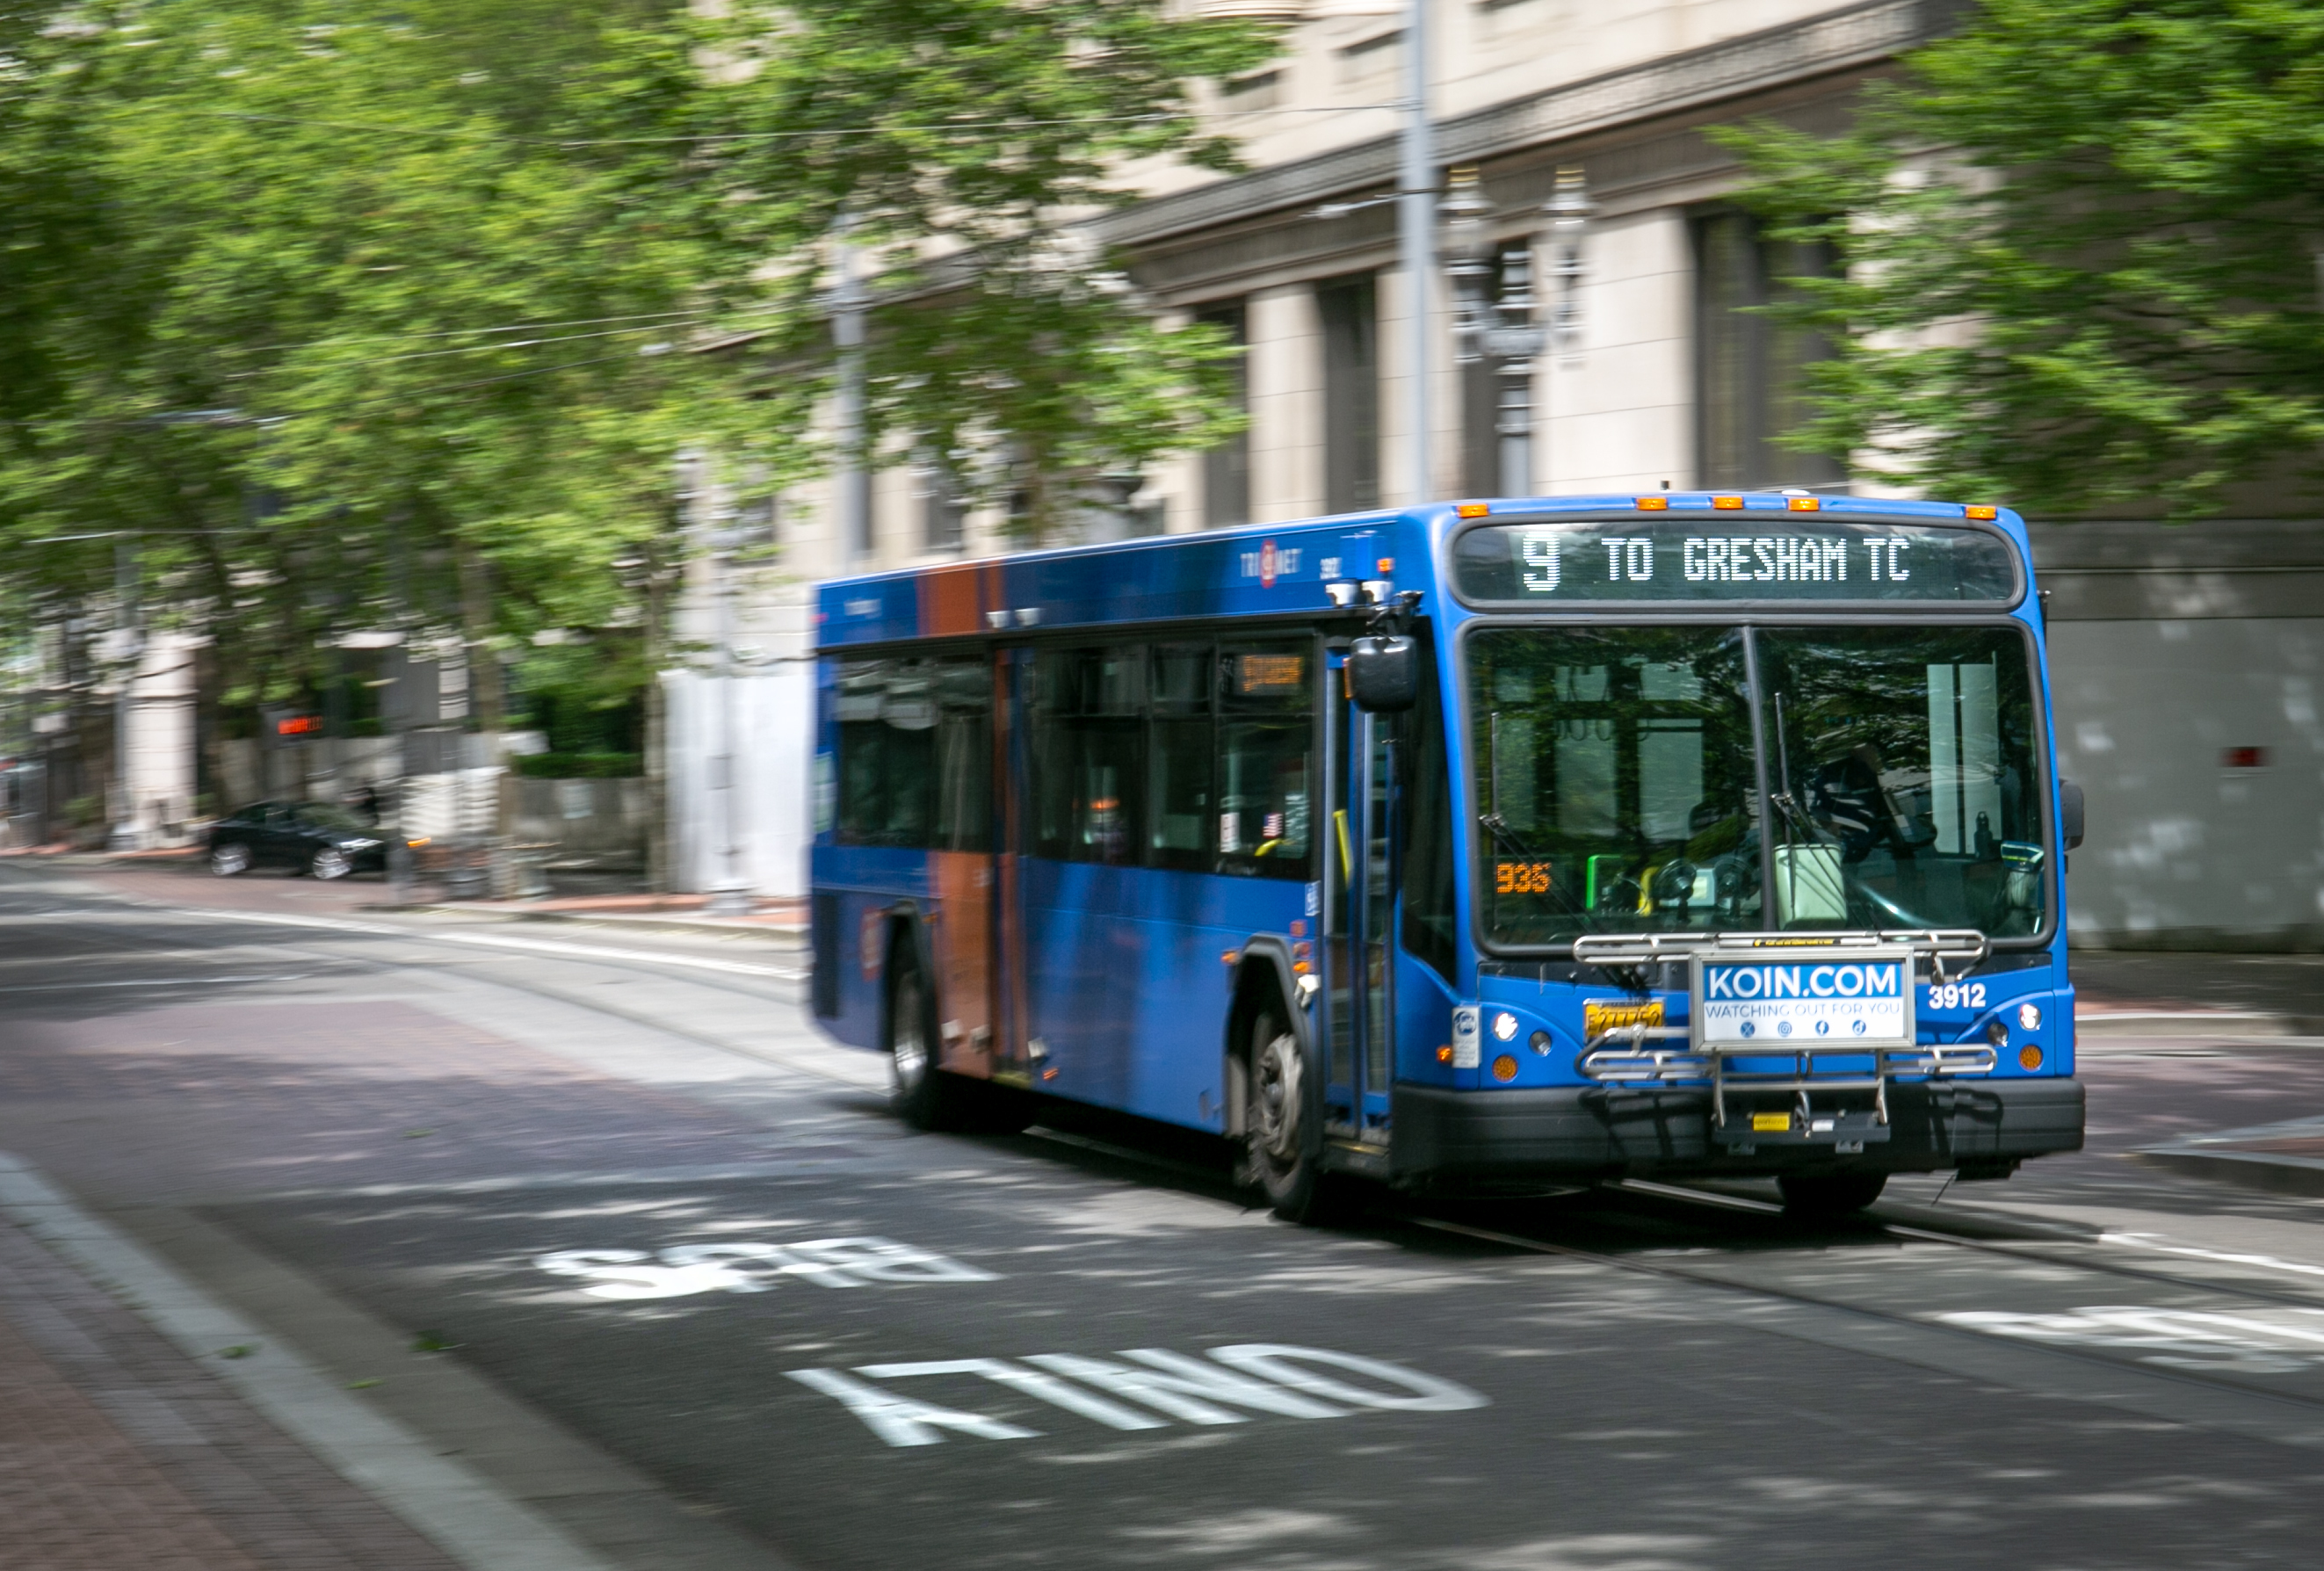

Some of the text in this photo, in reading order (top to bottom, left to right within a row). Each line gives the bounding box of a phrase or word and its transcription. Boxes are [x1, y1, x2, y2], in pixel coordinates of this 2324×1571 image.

[1524, 532, 1910, 591] 9 TO GRESHAM TC
[1709, 965, 1896, 998] KOIN.COM
[1929, 983, 1987, 1010] 3912
[1705, 1002, 1900, 1018] WATCHING OUT FOR YOU
[532, 1237, 1003, 1300] BUS
[779, 1344, 1492, 1447] ONLY
